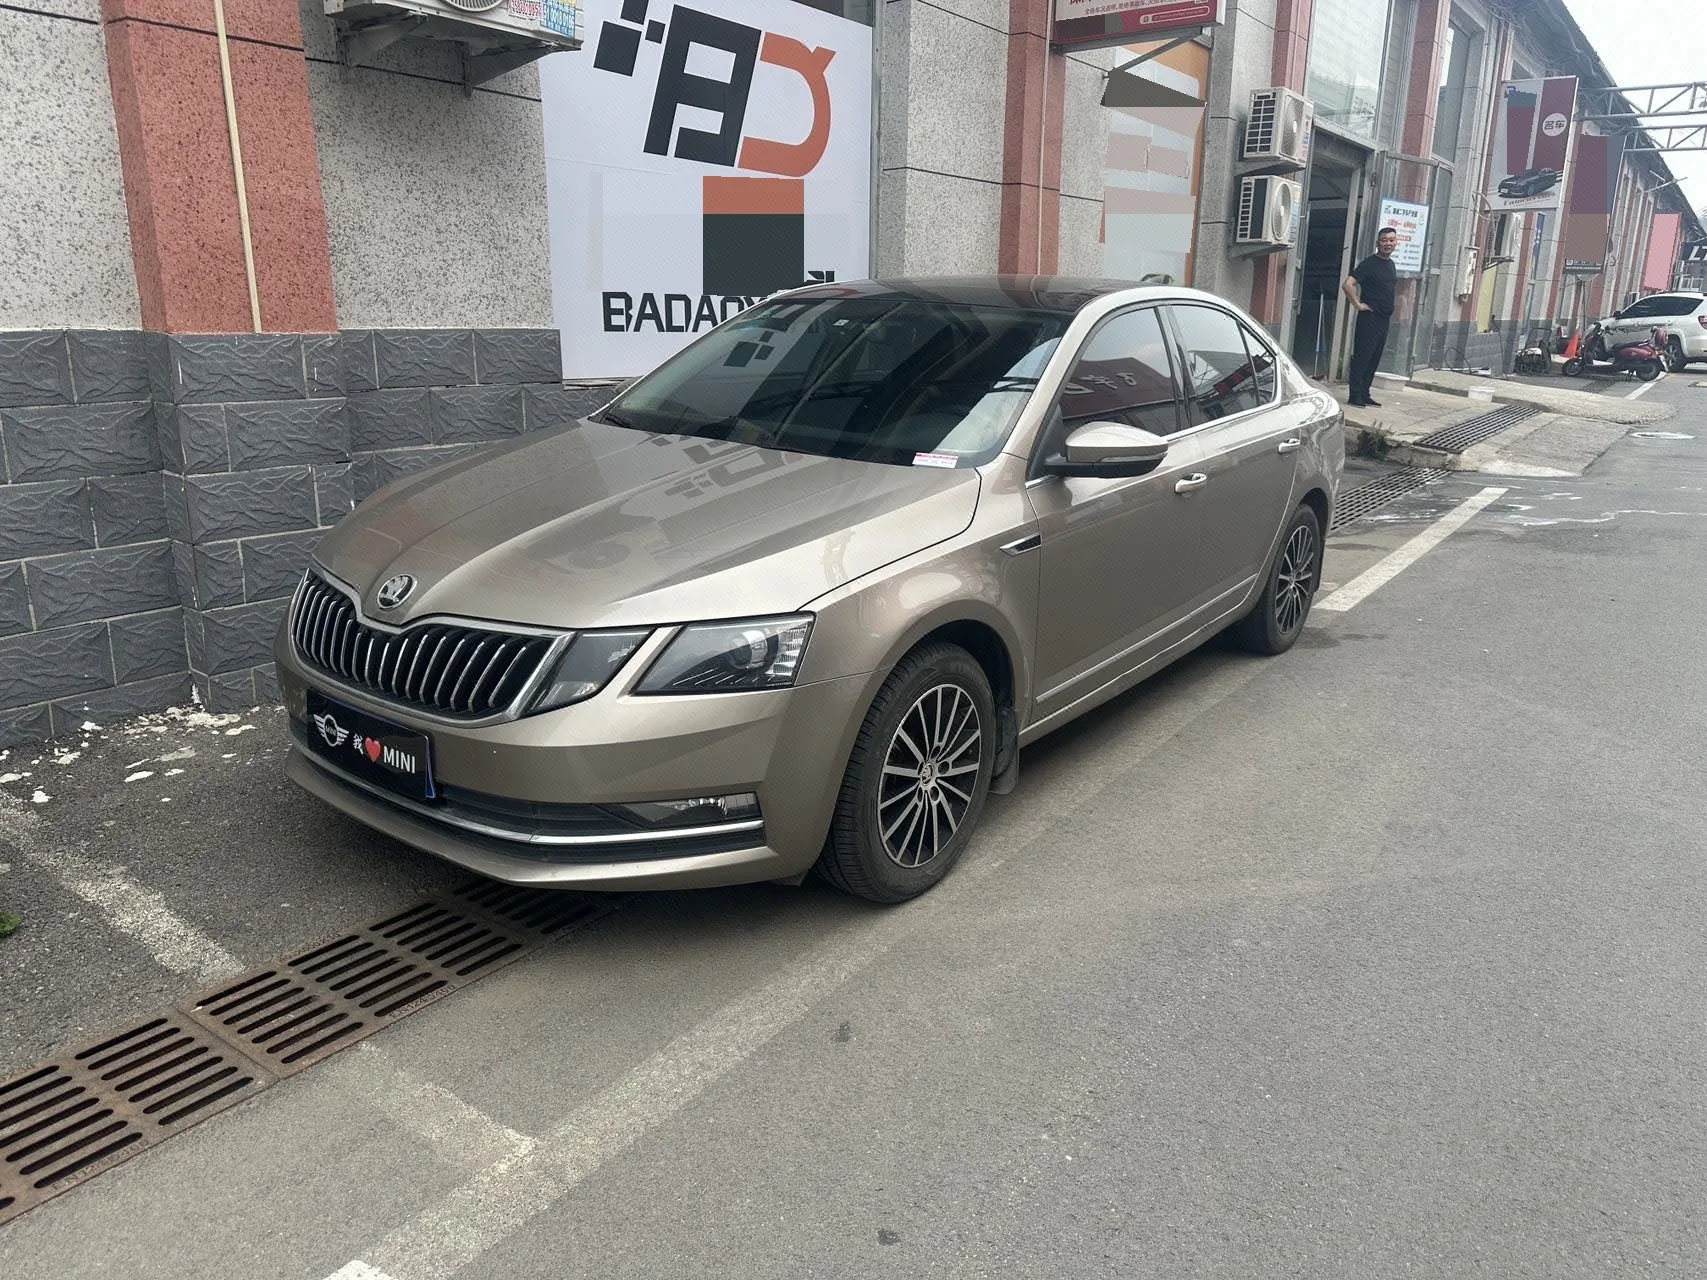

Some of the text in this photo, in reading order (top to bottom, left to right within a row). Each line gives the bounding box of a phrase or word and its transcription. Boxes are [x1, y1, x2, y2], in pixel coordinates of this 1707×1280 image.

[1544, 120, 1566, 130] 名车
[352, 733, 416, 774] 我 MINI
